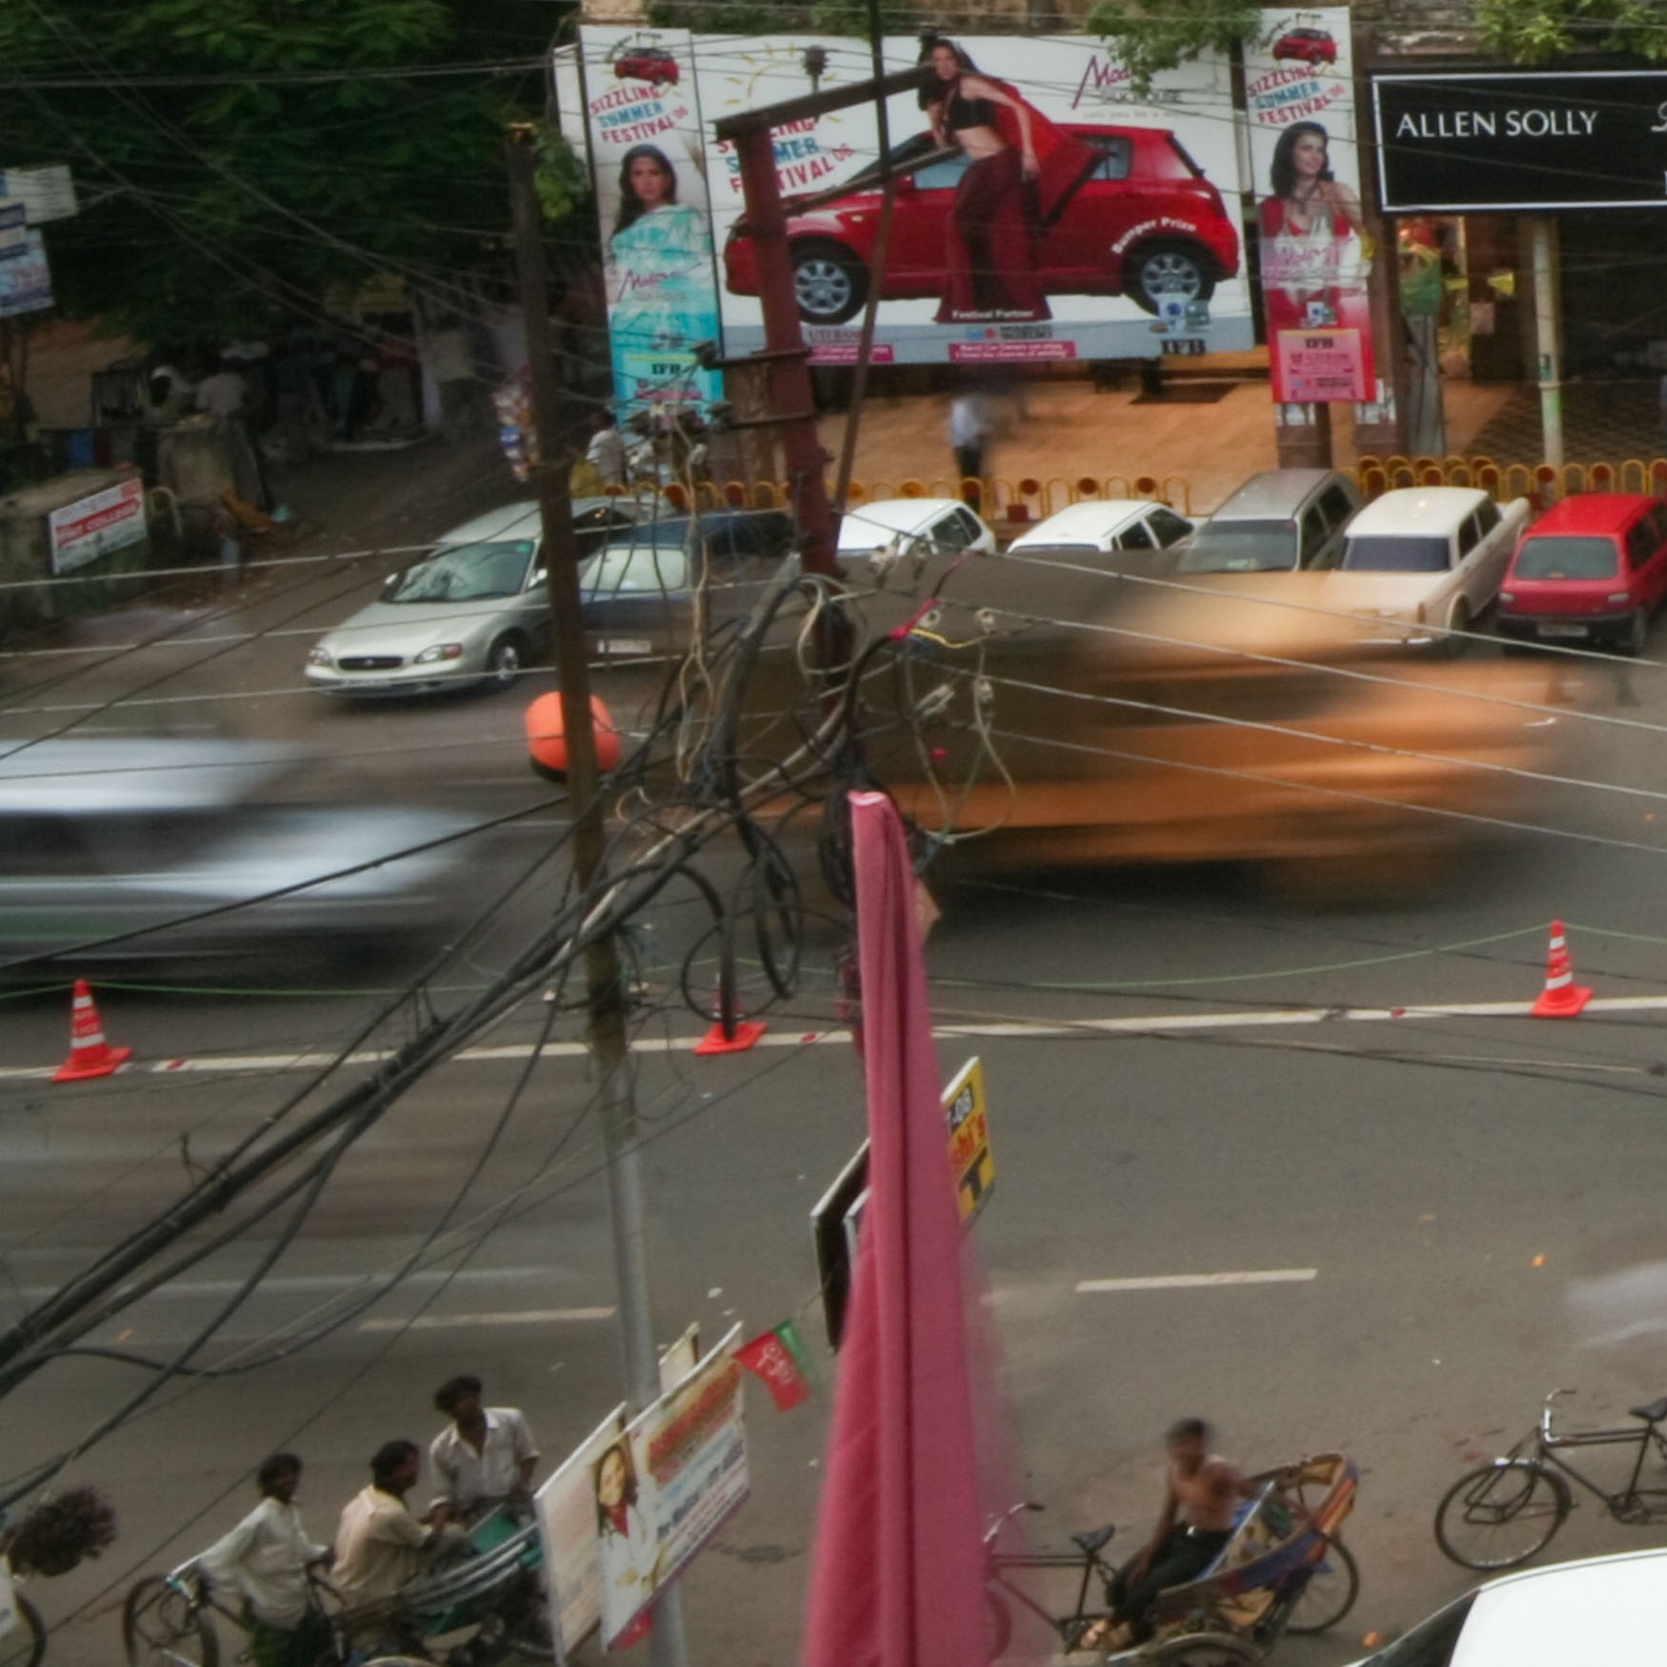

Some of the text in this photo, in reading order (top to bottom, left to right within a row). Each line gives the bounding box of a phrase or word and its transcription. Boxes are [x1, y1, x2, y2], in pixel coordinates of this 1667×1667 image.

[1246, 65, 1317, 97] SIZZLING
[1256, 81, 1320, 109] SUMMER
[590, 86, 662, 114] SIZZLING
[1257, 95, 1332, 124] FESTIVAL
[598, 101, 663, 128] SUMMER
[1396, 110, 1598, 138] ALLEN SOLLY
[602, 115, 676, 143] FESTIVAL
[1161, 216, 1197, 232] Prize
